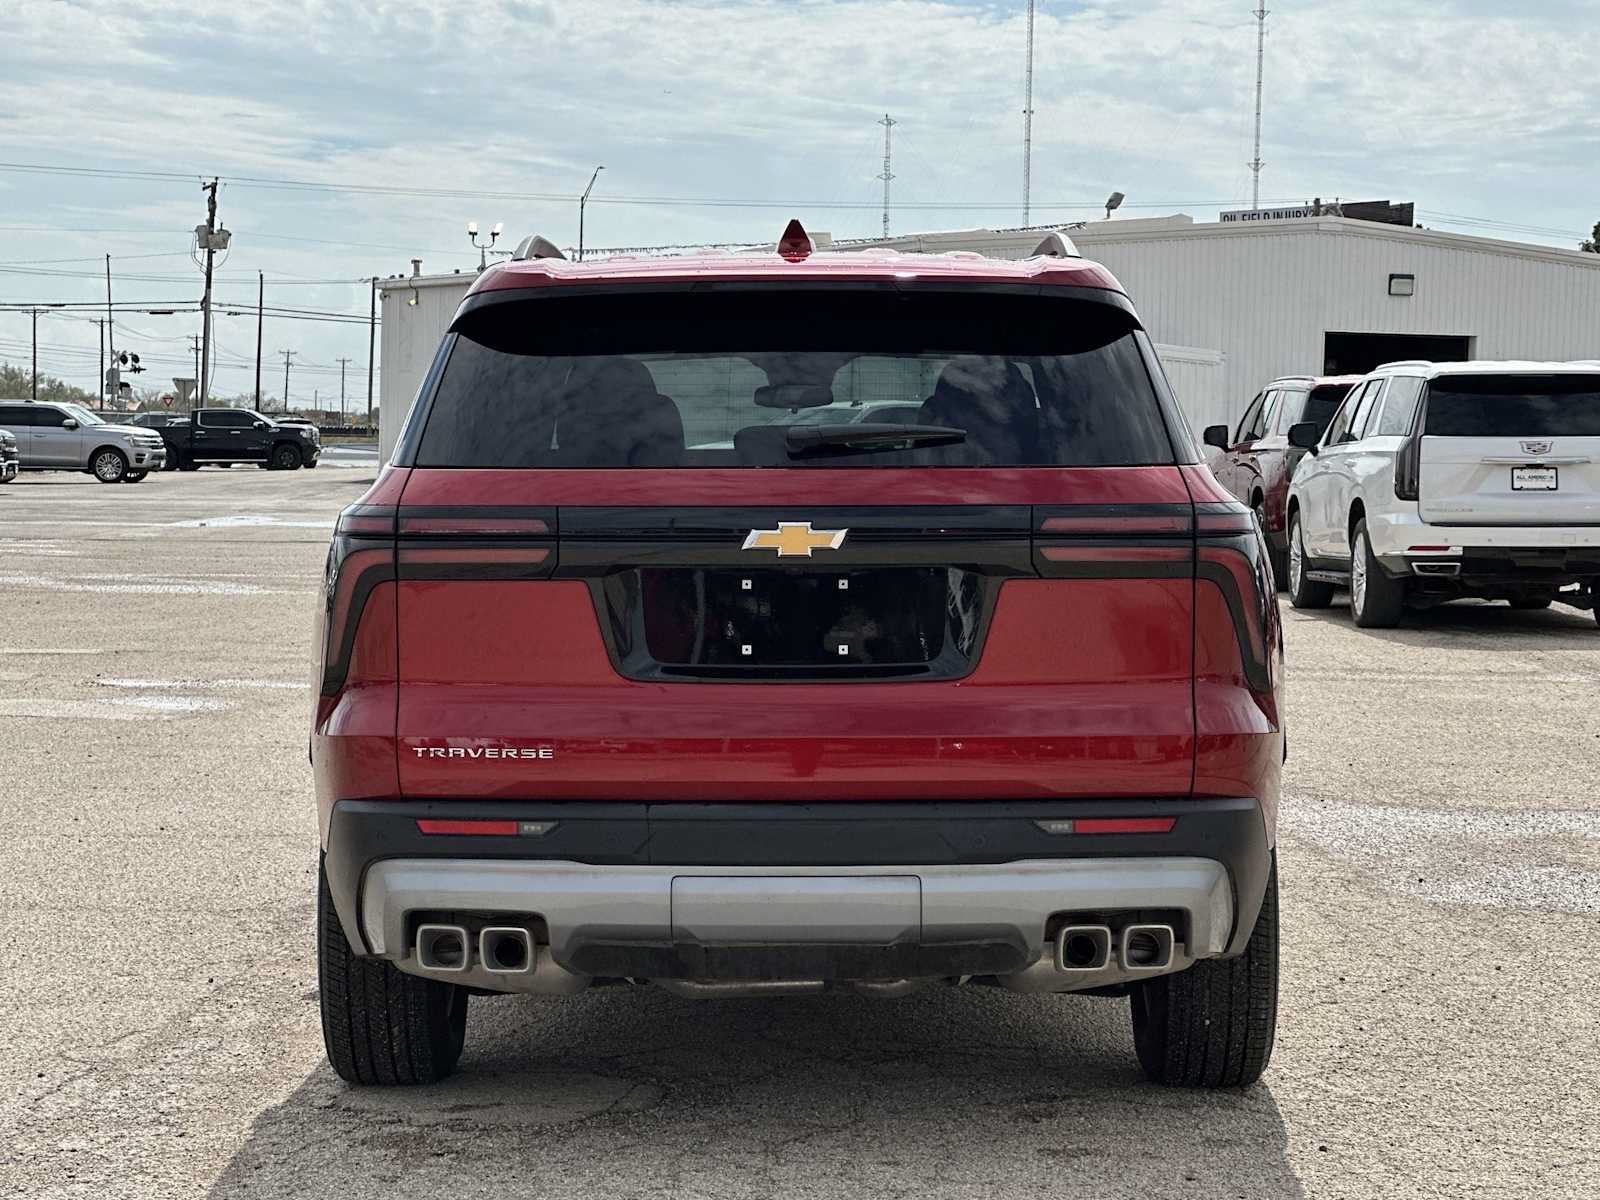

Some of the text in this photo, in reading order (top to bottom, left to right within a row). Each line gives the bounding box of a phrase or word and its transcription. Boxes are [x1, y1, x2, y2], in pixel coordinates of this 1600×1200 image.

[1223, 214, 1237, 222] OIL
[1242, 211, 1271, 221] FIELD
[412, 747, 554, 759] TRAVERSE
